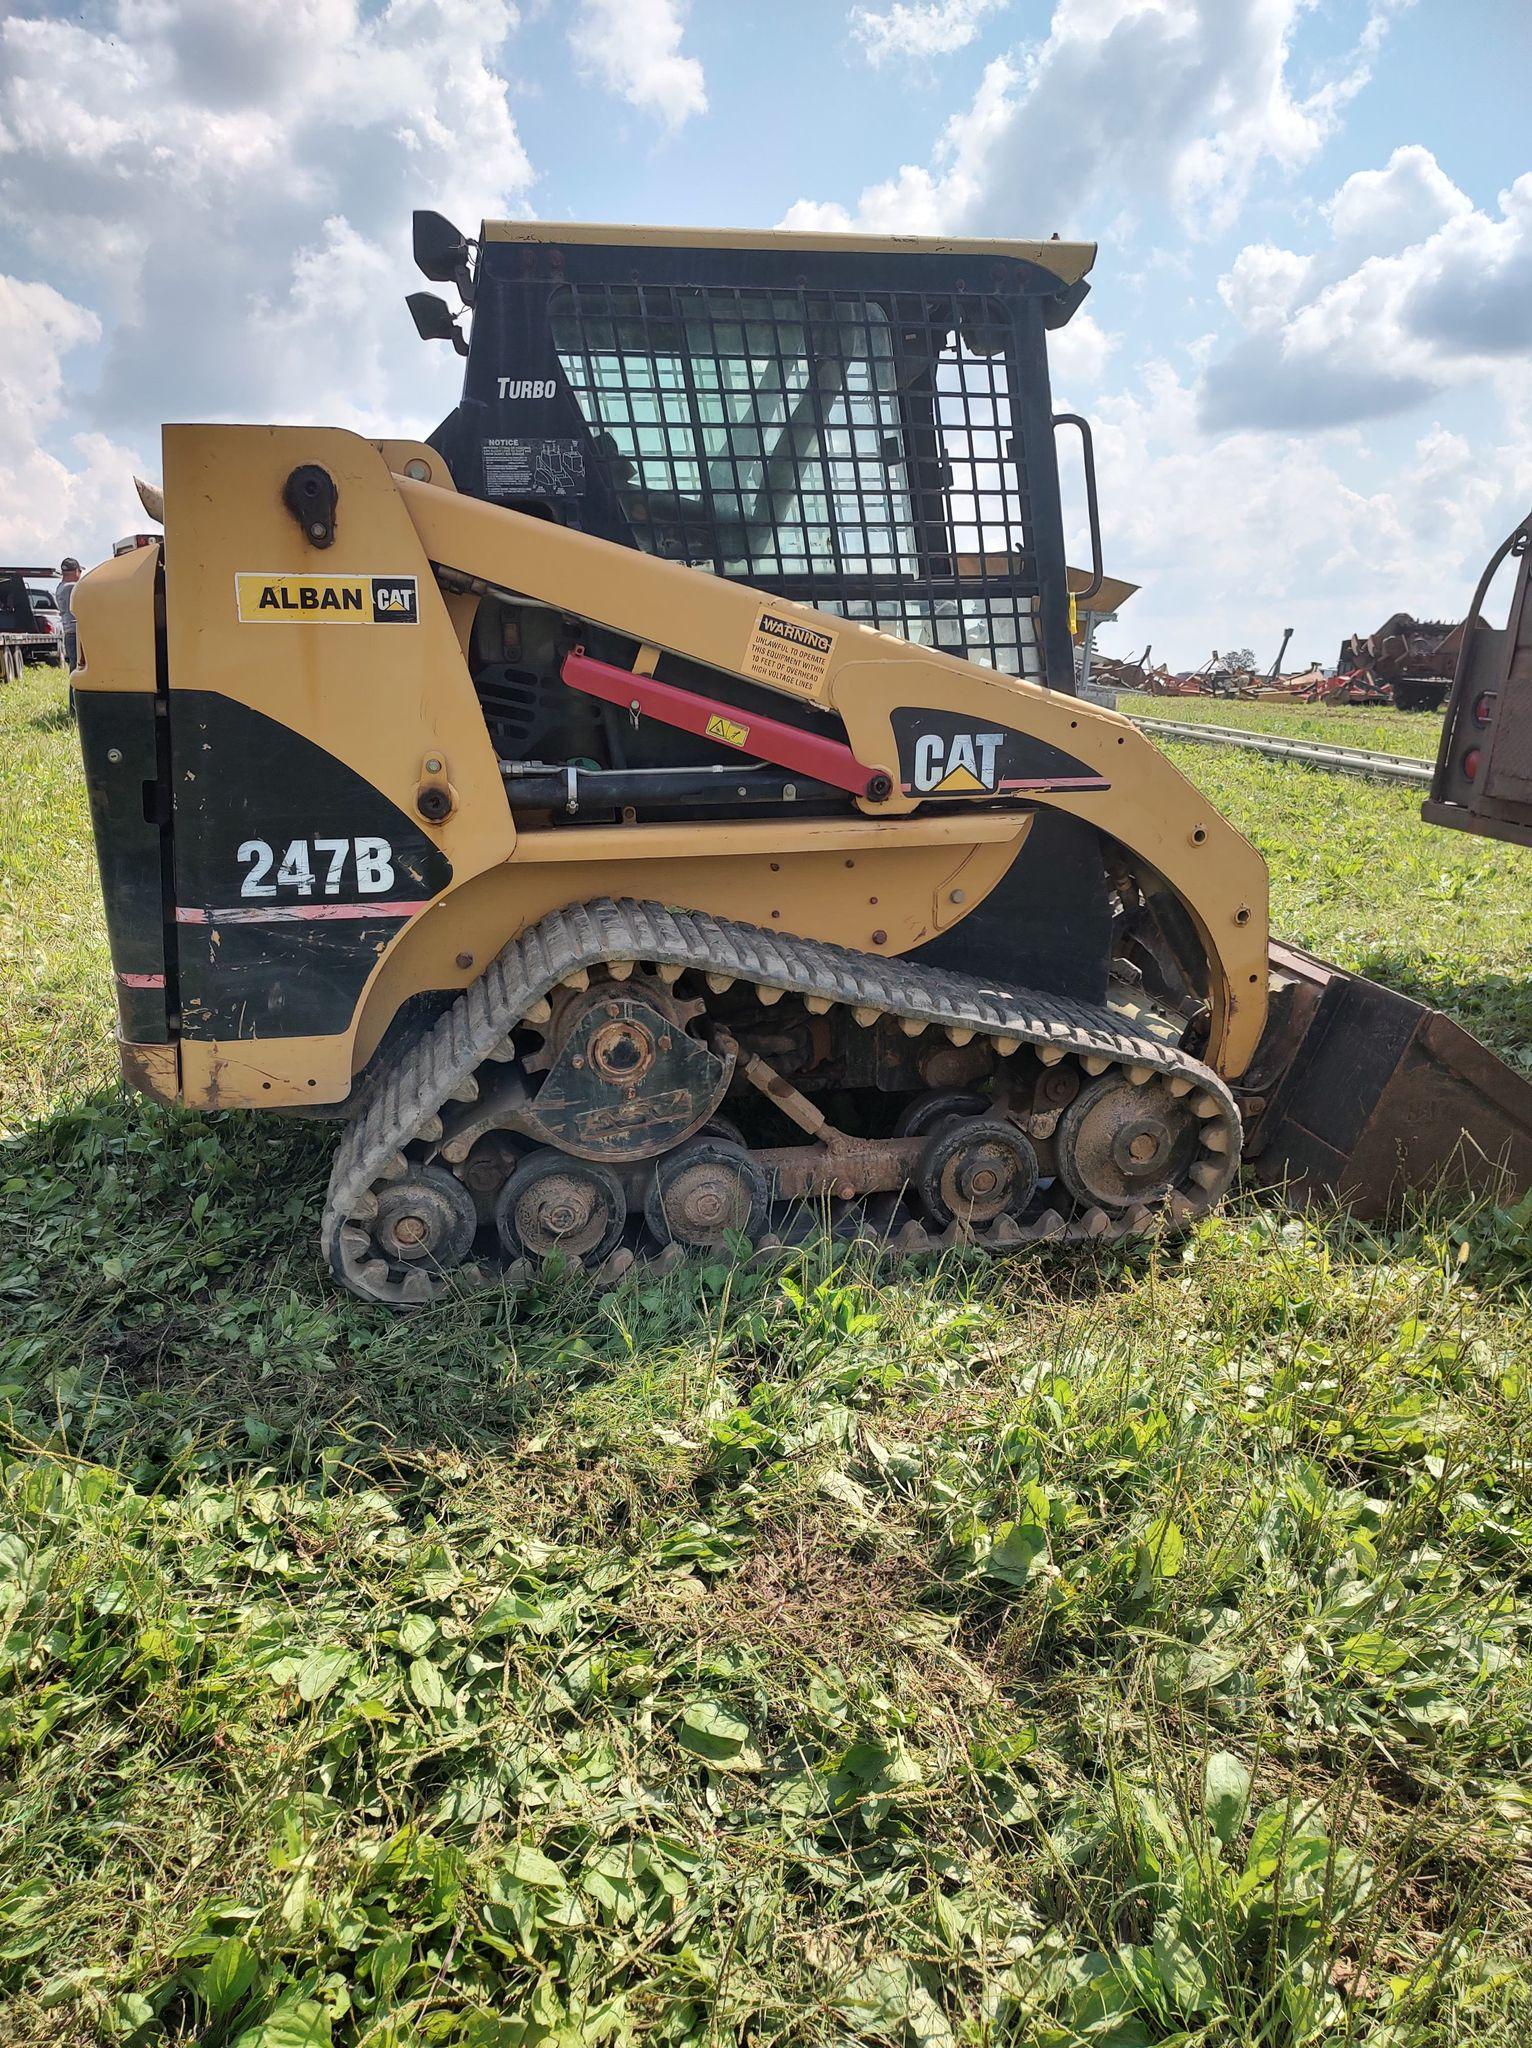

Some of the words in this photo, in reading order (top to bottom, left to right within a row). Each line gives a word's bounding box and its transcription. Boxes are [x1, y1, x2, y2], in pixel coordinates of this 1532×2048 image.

[497, 377, 557, 399] TURBO
[259, 587, 363, 610] ALBAN
[377, 588, 413, 611] CAT
[763, 617, 829, 651] WARNING
[751, 644, 766, 654] THIS
[766, 649, 801, 667] EQUIPMENT
[802, 661, 825, 674] WITHIN
[755, 636, 789, 653] UNLAWFUL
[790, 647, 799, 656] TO
[799, 650, 826, 666] OPERATE
[751, 664, 768, 674] HIGH
[768, 669, 795, 684] VOLTAGE
[795, 678, 814, 690] LINES
[752, 655, 759, 663] 10
[760, 657, 776, 668] FEET
[776, 662, 785, 670] OF
[786, 666, 819, 682] OVERHEAD
[915, 733, 1004, 792] CAT
[237, 837, 395, 897] 247B
